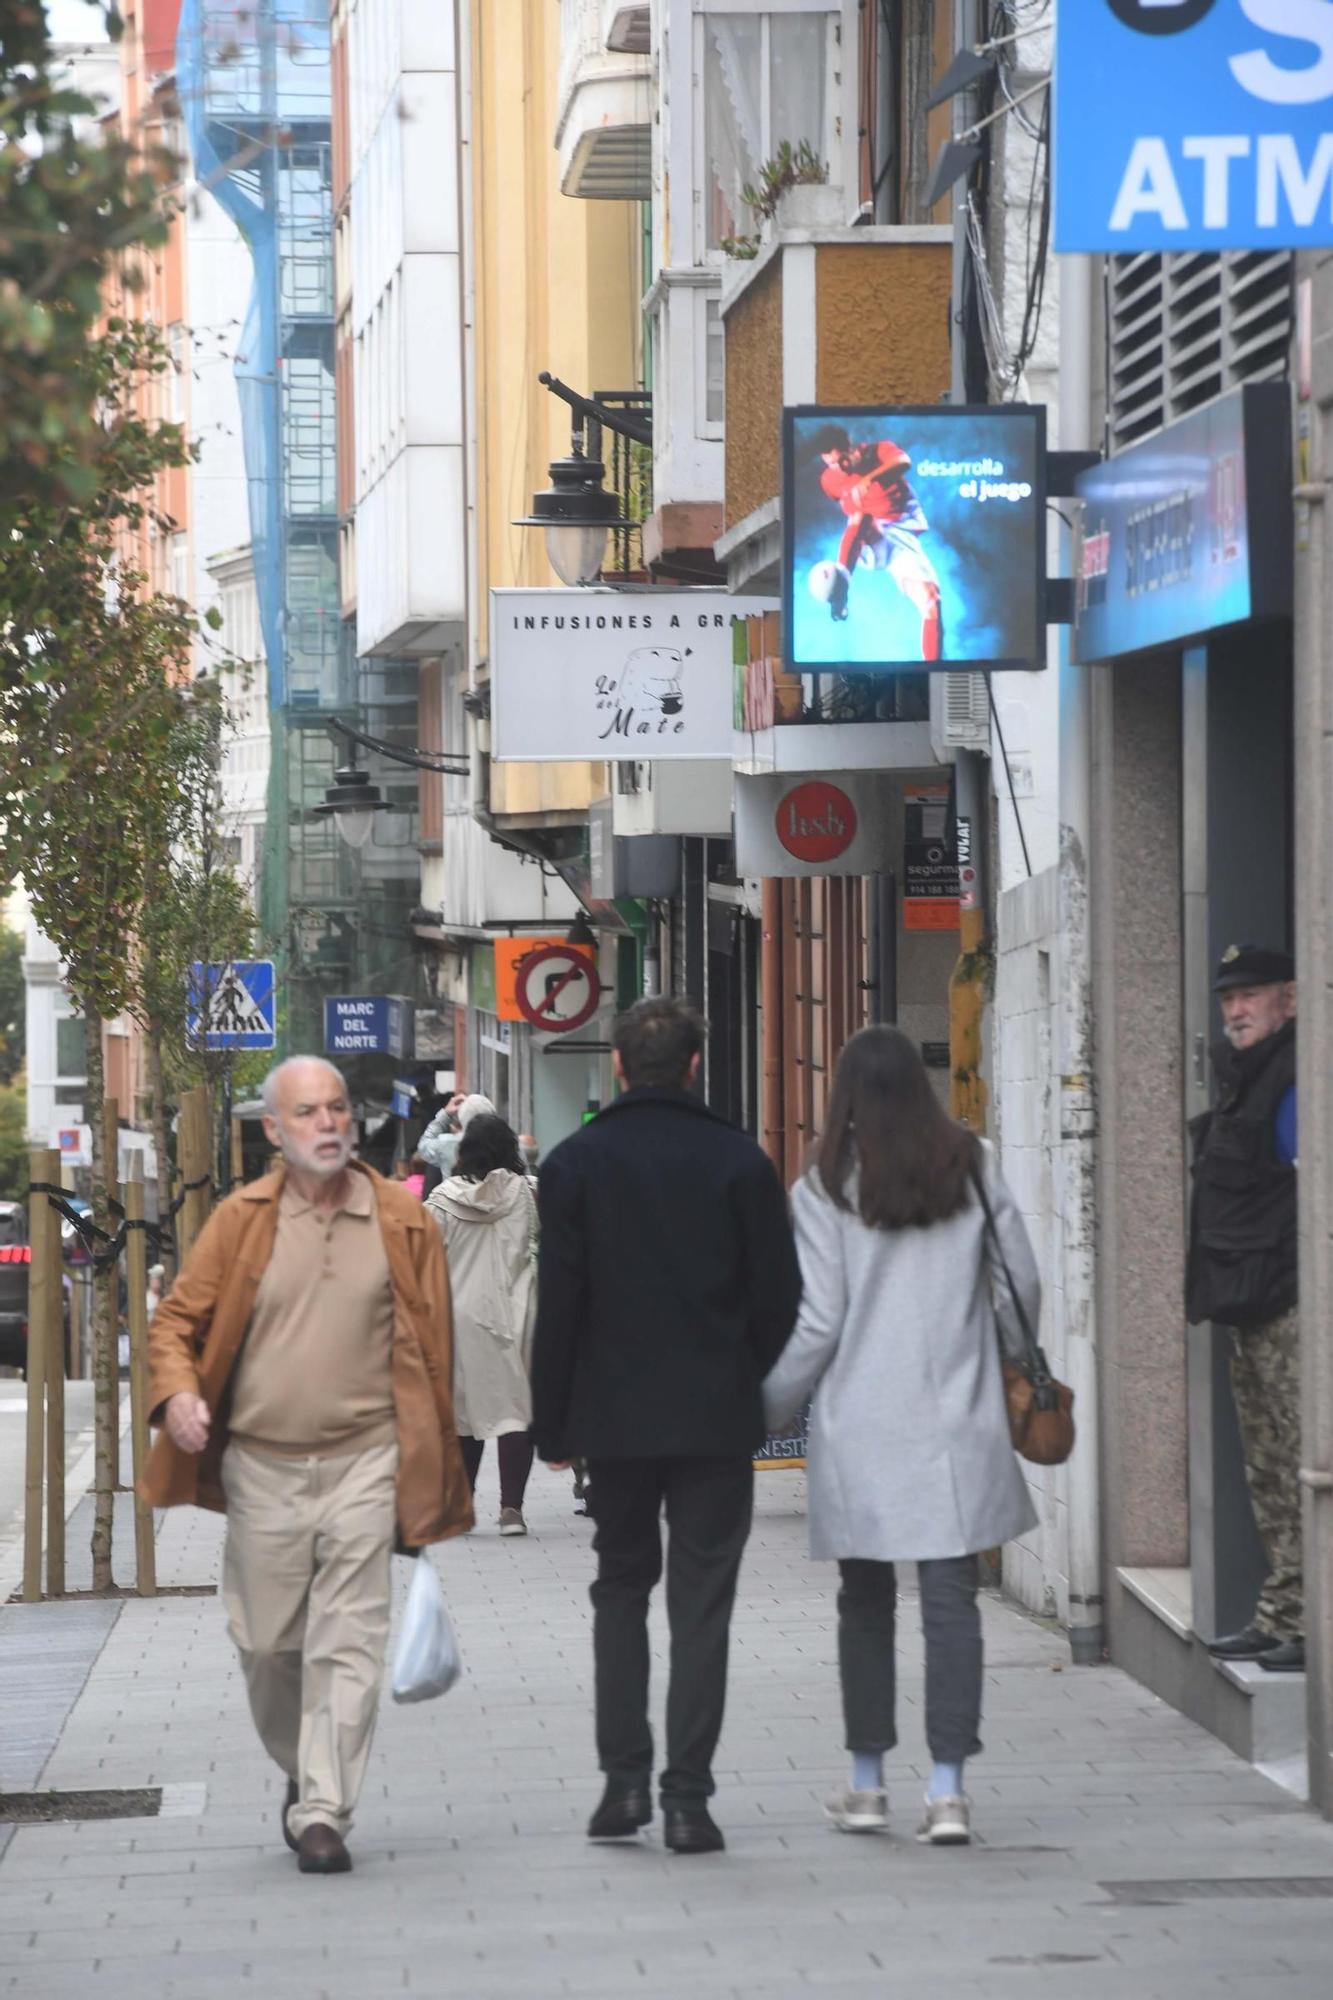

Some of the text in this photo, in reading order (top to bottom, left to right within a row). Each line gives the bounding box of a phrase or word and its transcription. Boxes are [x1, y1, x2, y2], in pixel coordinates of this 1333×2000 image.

[1108, 132, 1333, 231] ATM
[917, 458, 1004, 477] desarrolla
[959, 479, 1032, 502] el juego
[513, 615, 653, 630] INFUSIONES
[669, 614, 681, 628] A
[598, 706, 685, 739] Mate
[336, 1002, 376, 1016] MARC
[342, 1020, 369, 1033] DEL
[334, 1035, 379, 1049] NORTE
